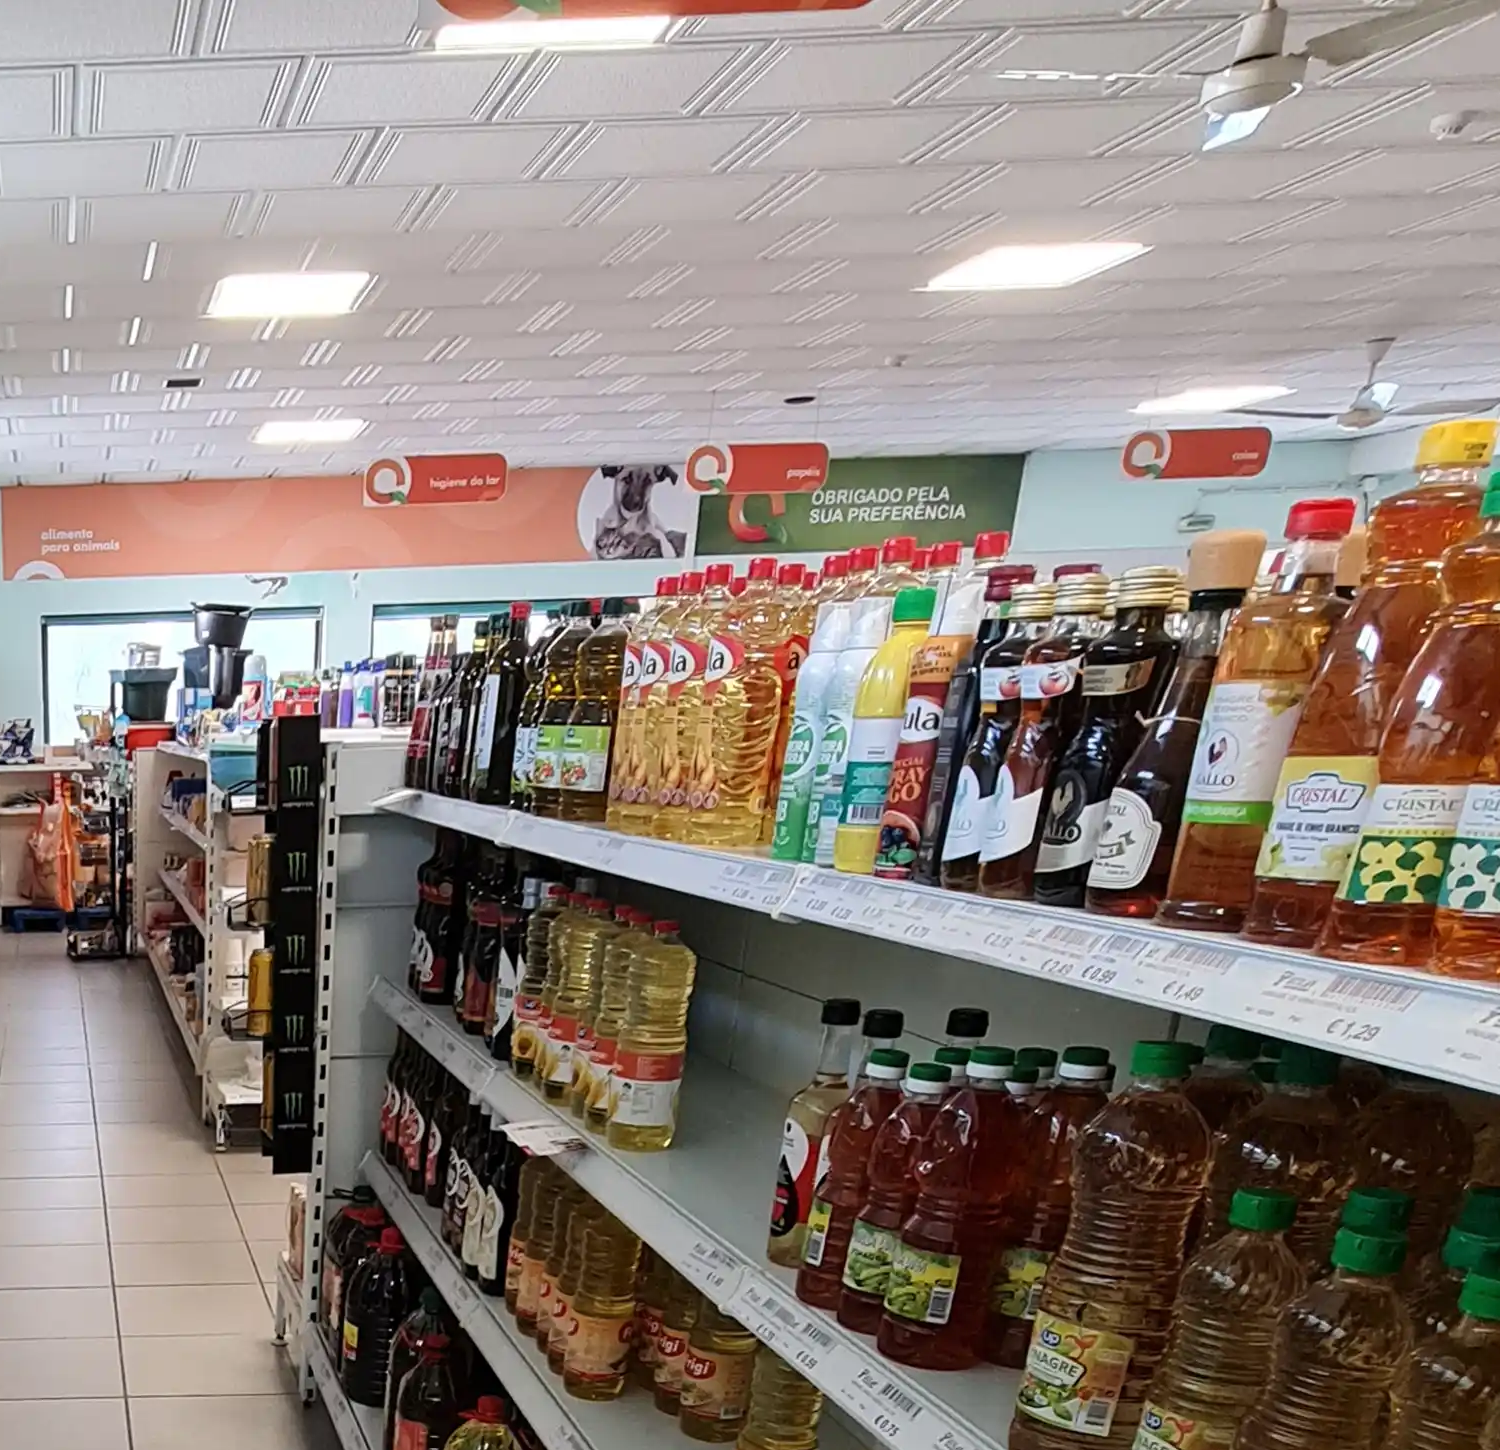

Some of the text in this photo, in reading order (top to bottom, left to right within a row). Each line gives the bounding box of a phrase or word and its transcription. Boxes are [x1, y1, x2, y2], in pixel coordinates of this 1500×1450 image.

[429, 475, 501, 490] higiene do lar
[811, 487, 951, 506] OBRIGADO PELA
[808, 500, 967, 524] SUA PREFERÊNCIA
[41, 528, 93, 541] alimento
[41, 539, 120, 555] para animais
